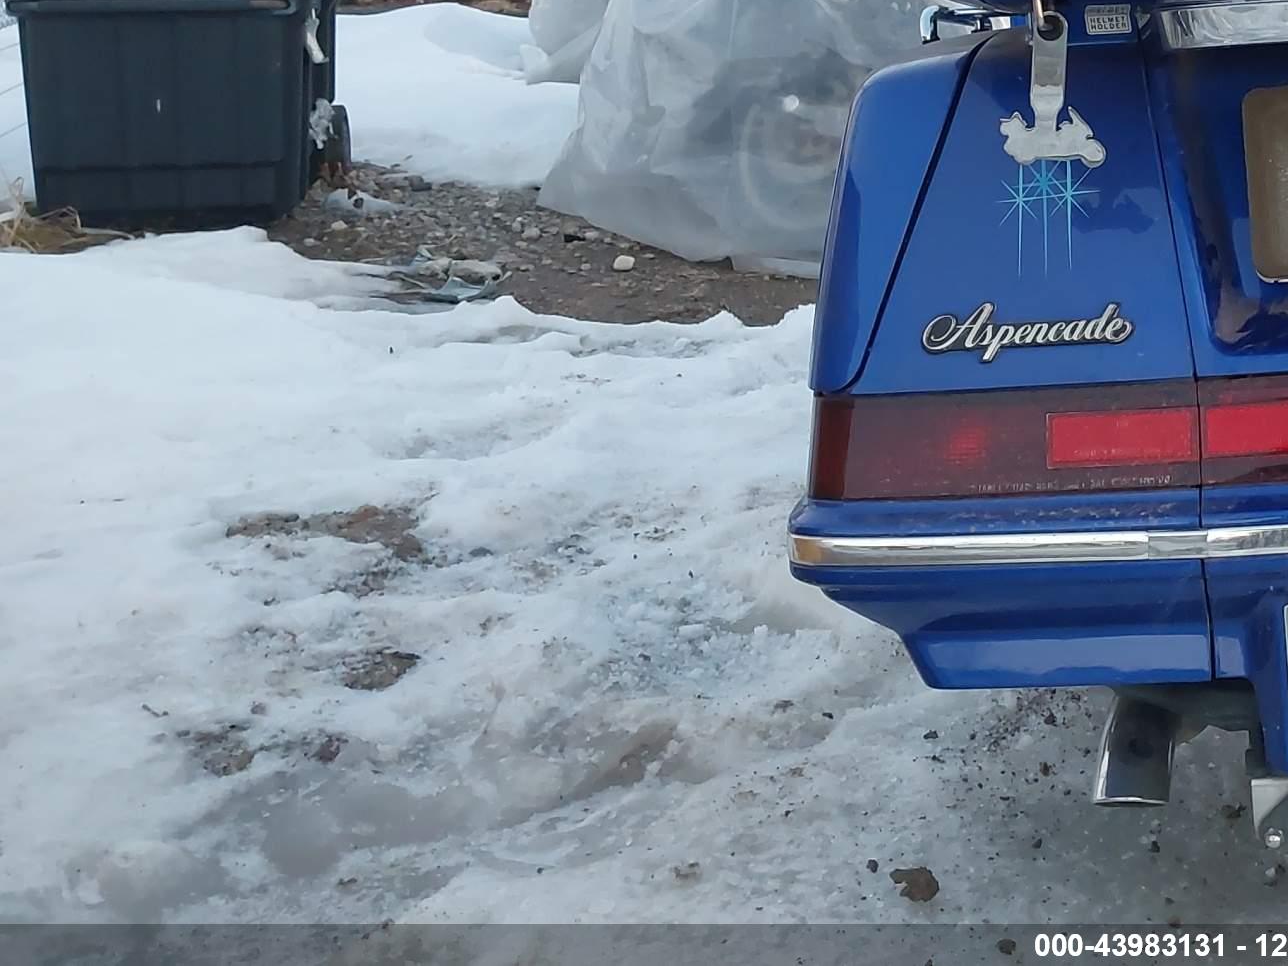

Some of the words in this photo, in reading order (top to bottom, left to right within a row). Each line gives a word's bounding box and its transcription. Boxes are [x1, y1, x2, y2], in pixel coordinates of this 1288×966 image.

[1089, 16, 1126, 24] HELMET
[1090, 22, 1127, 31] HOLDER
[921, 301, 1134, 363] Aspencade
